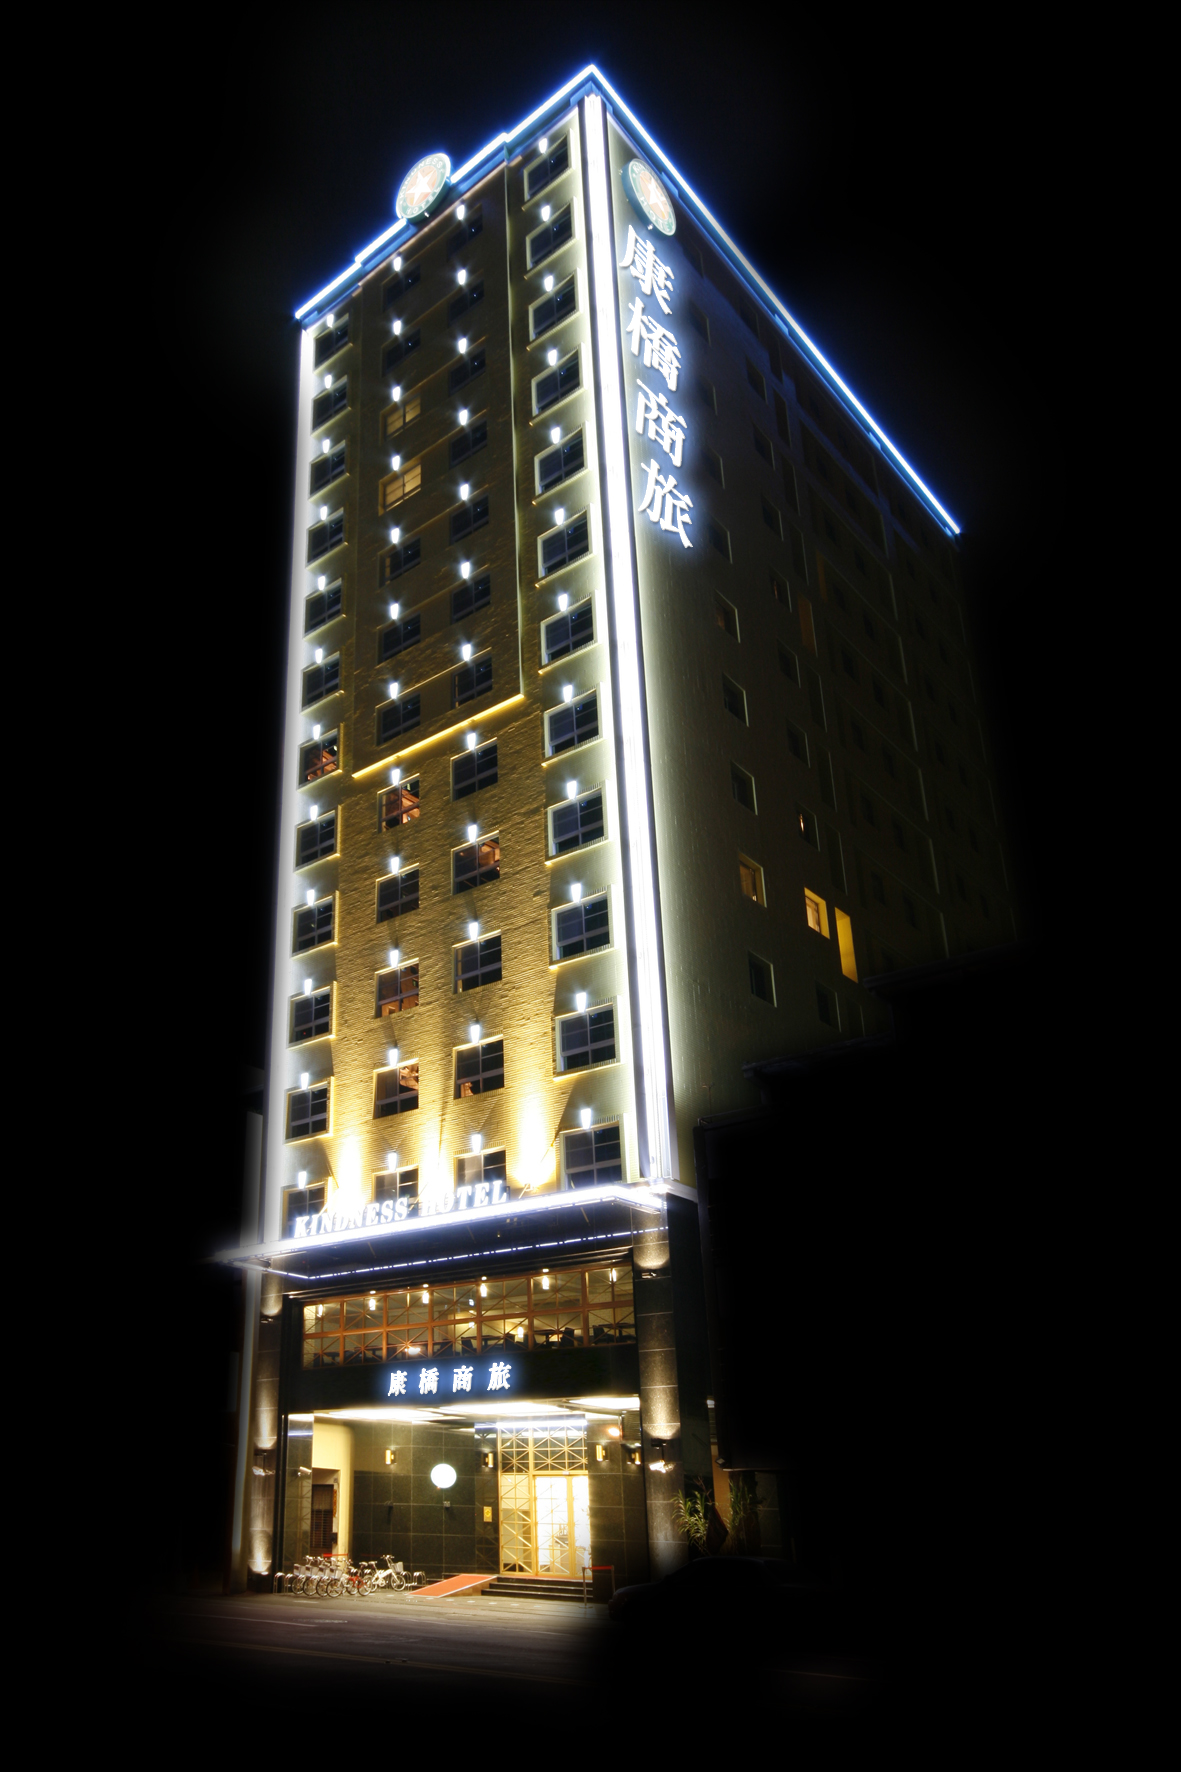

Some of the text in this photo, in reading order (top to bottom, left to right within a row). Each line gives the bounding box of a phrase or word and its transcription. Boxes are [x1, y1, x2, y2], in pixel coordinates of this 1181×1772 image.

[619, 224, 693, 549] 康橋商旅
[294, 1180, 507, 1238] KINDNESS HOTEL
[388, 1362, 512, 1397] 康橋商旅
